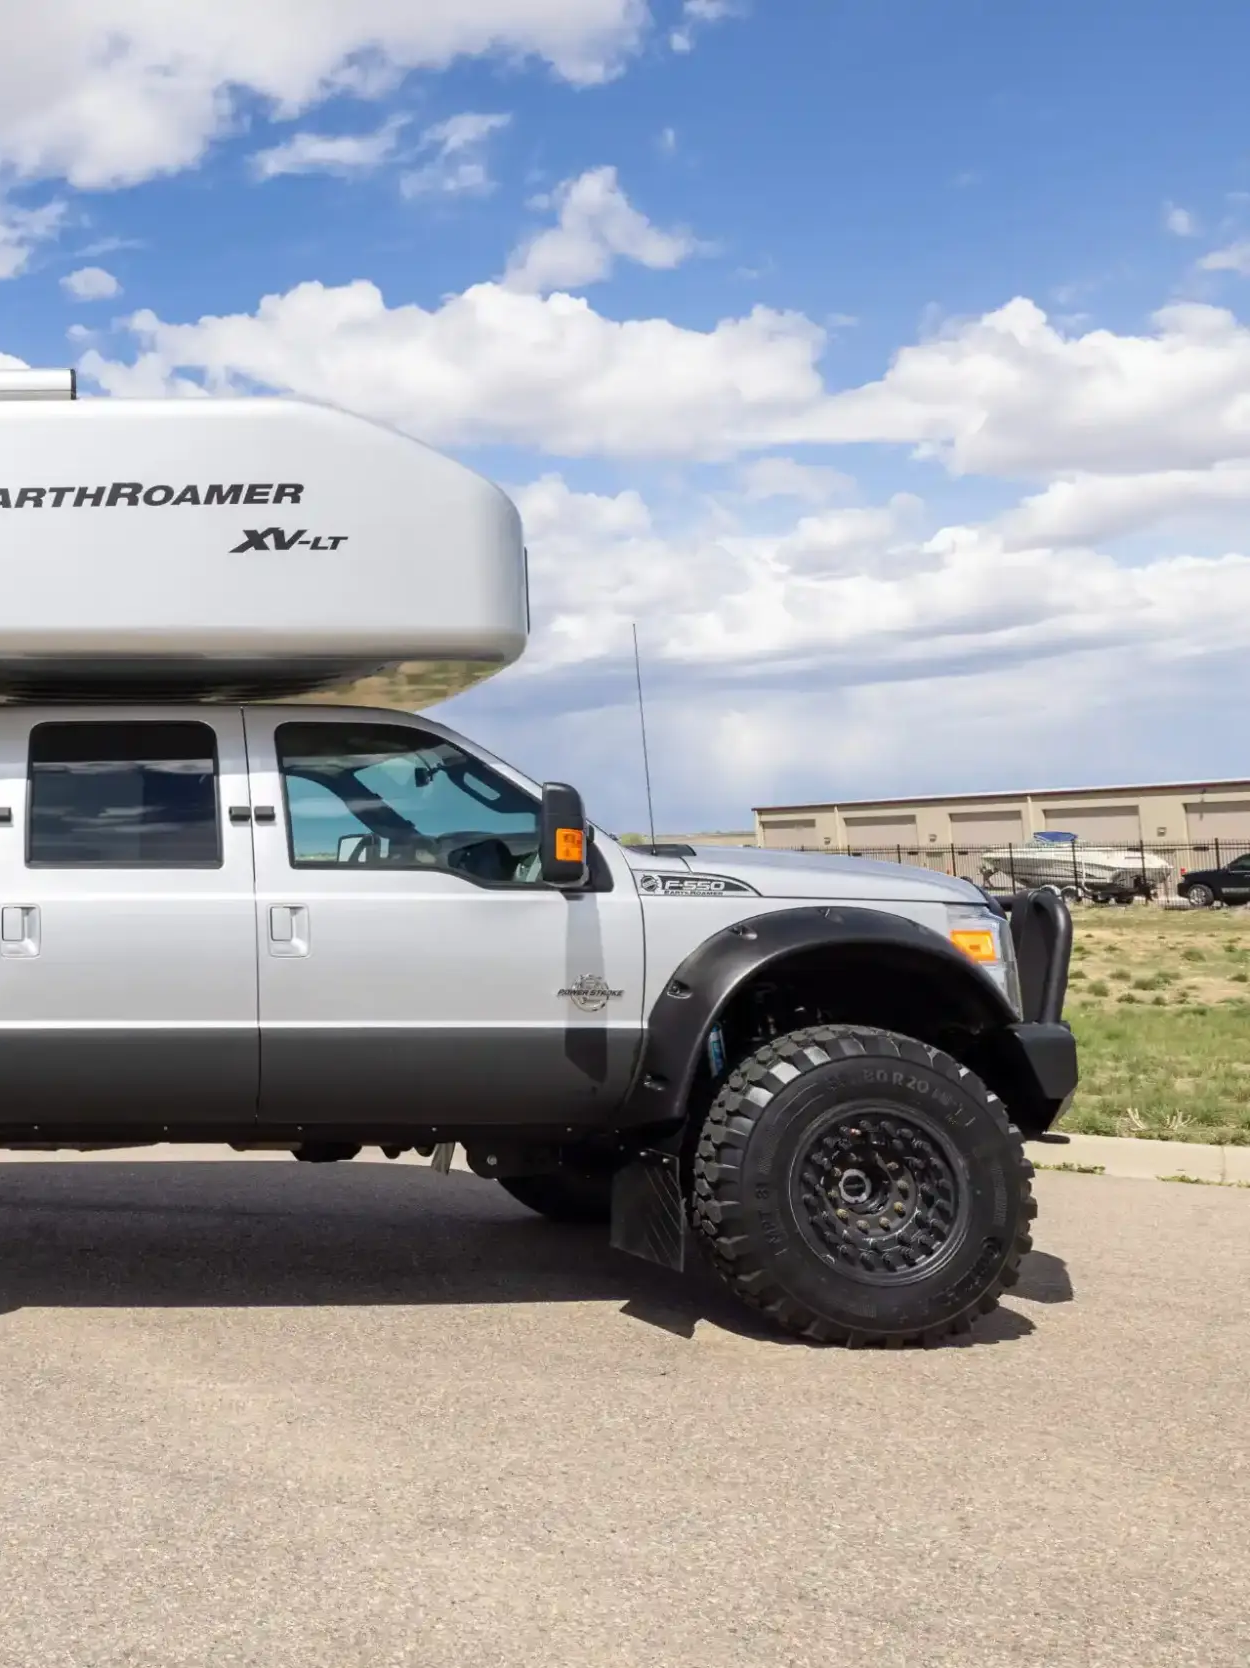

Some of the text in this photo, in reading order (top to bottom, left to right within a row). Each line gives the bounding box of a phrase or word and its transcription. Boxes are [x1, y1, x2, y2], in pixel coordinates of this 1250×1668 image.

[228, 527, 349, 554] XV-LT
[665, 880, 726, 891] F-550
[557, 989, 625, 997] POWER STROKE
